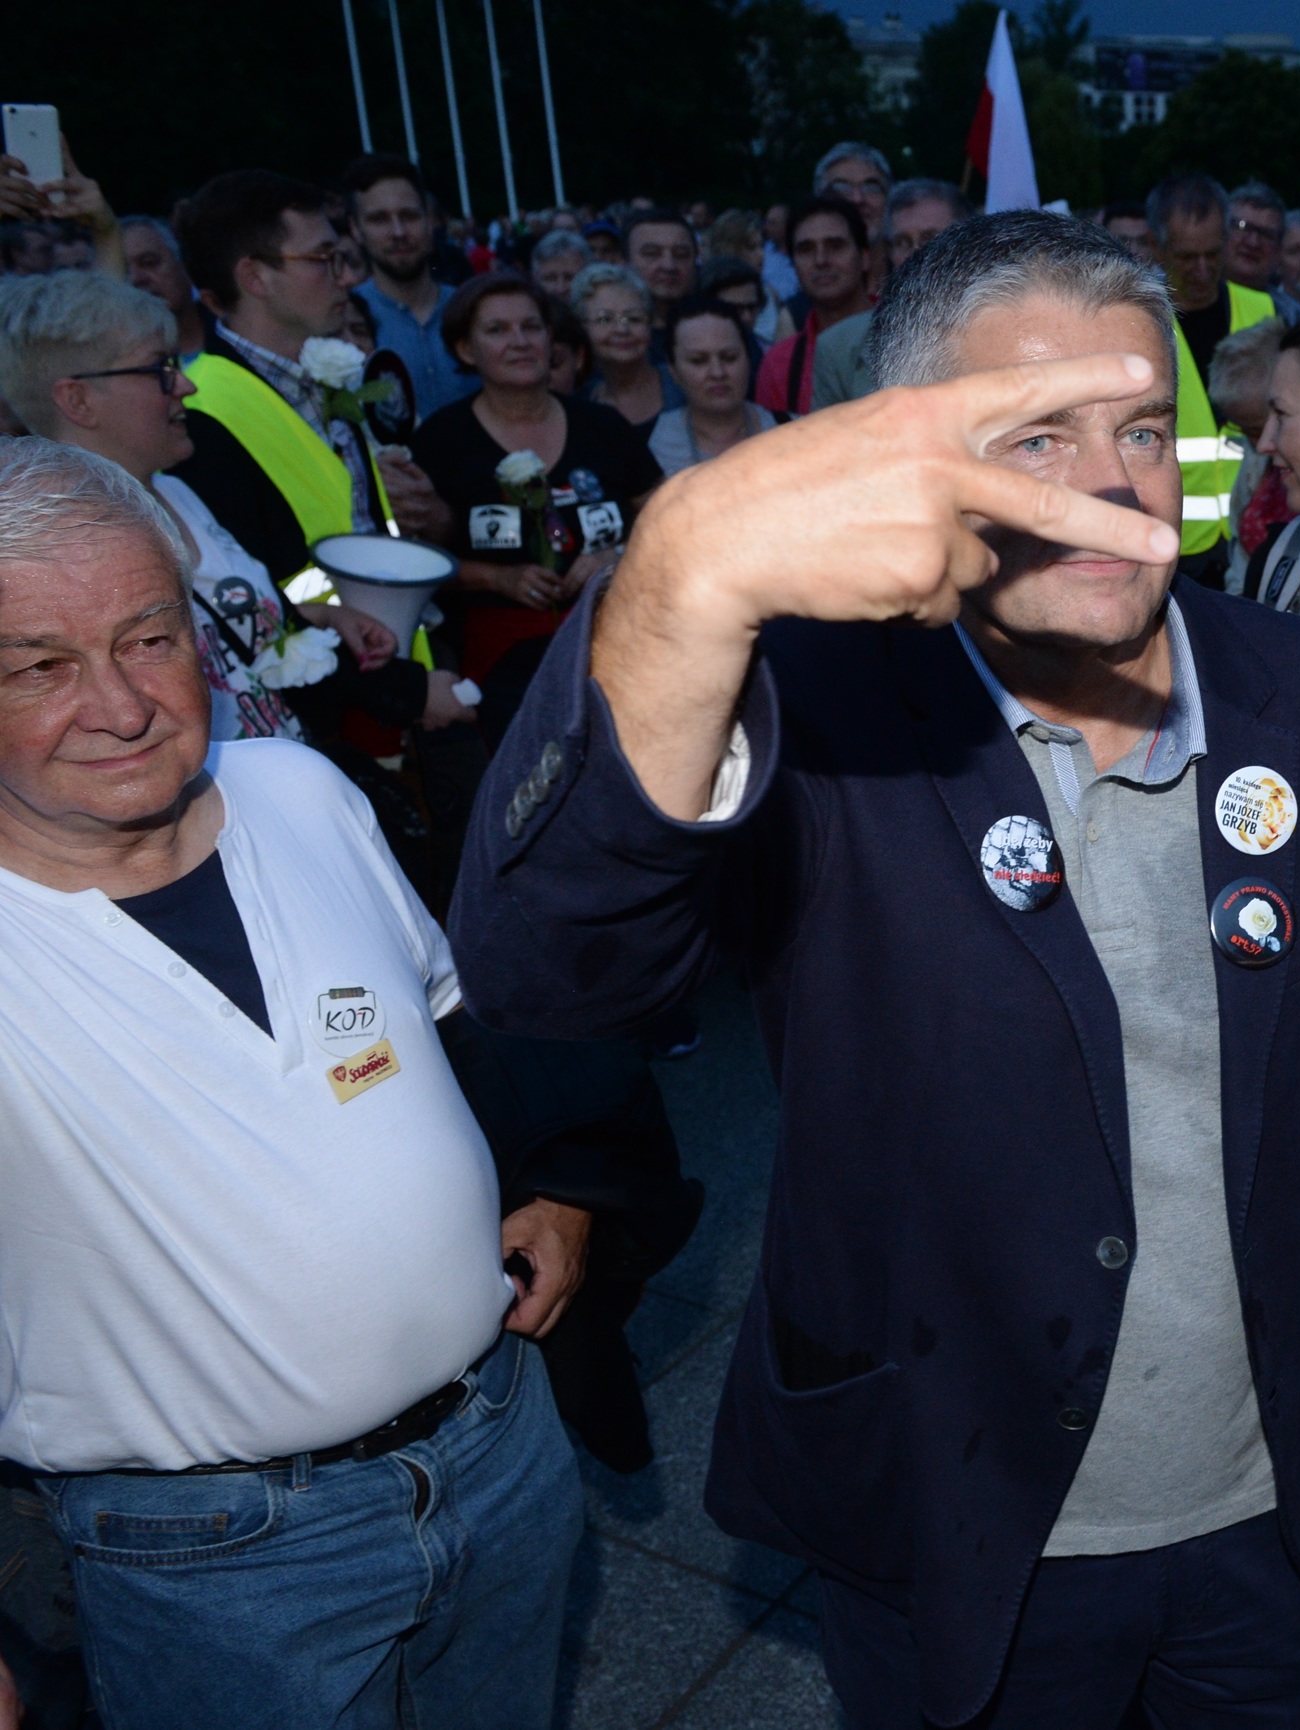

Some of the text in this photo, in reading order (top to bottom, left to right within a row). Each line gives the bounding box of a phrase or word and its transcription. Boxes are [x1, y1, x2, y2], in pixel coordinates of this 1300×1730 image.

[1224, 790, 1253, 804] nazywam
[1219, 799, 1262, 821] JAN JÓZEF
[1222, 813, 1258, 835] GRZYB
[1223, 890, 1240, 910] MAMY
[1240, 886, 1267, 894] PRAWO
[326, 1006, 375, 1032] KOD
